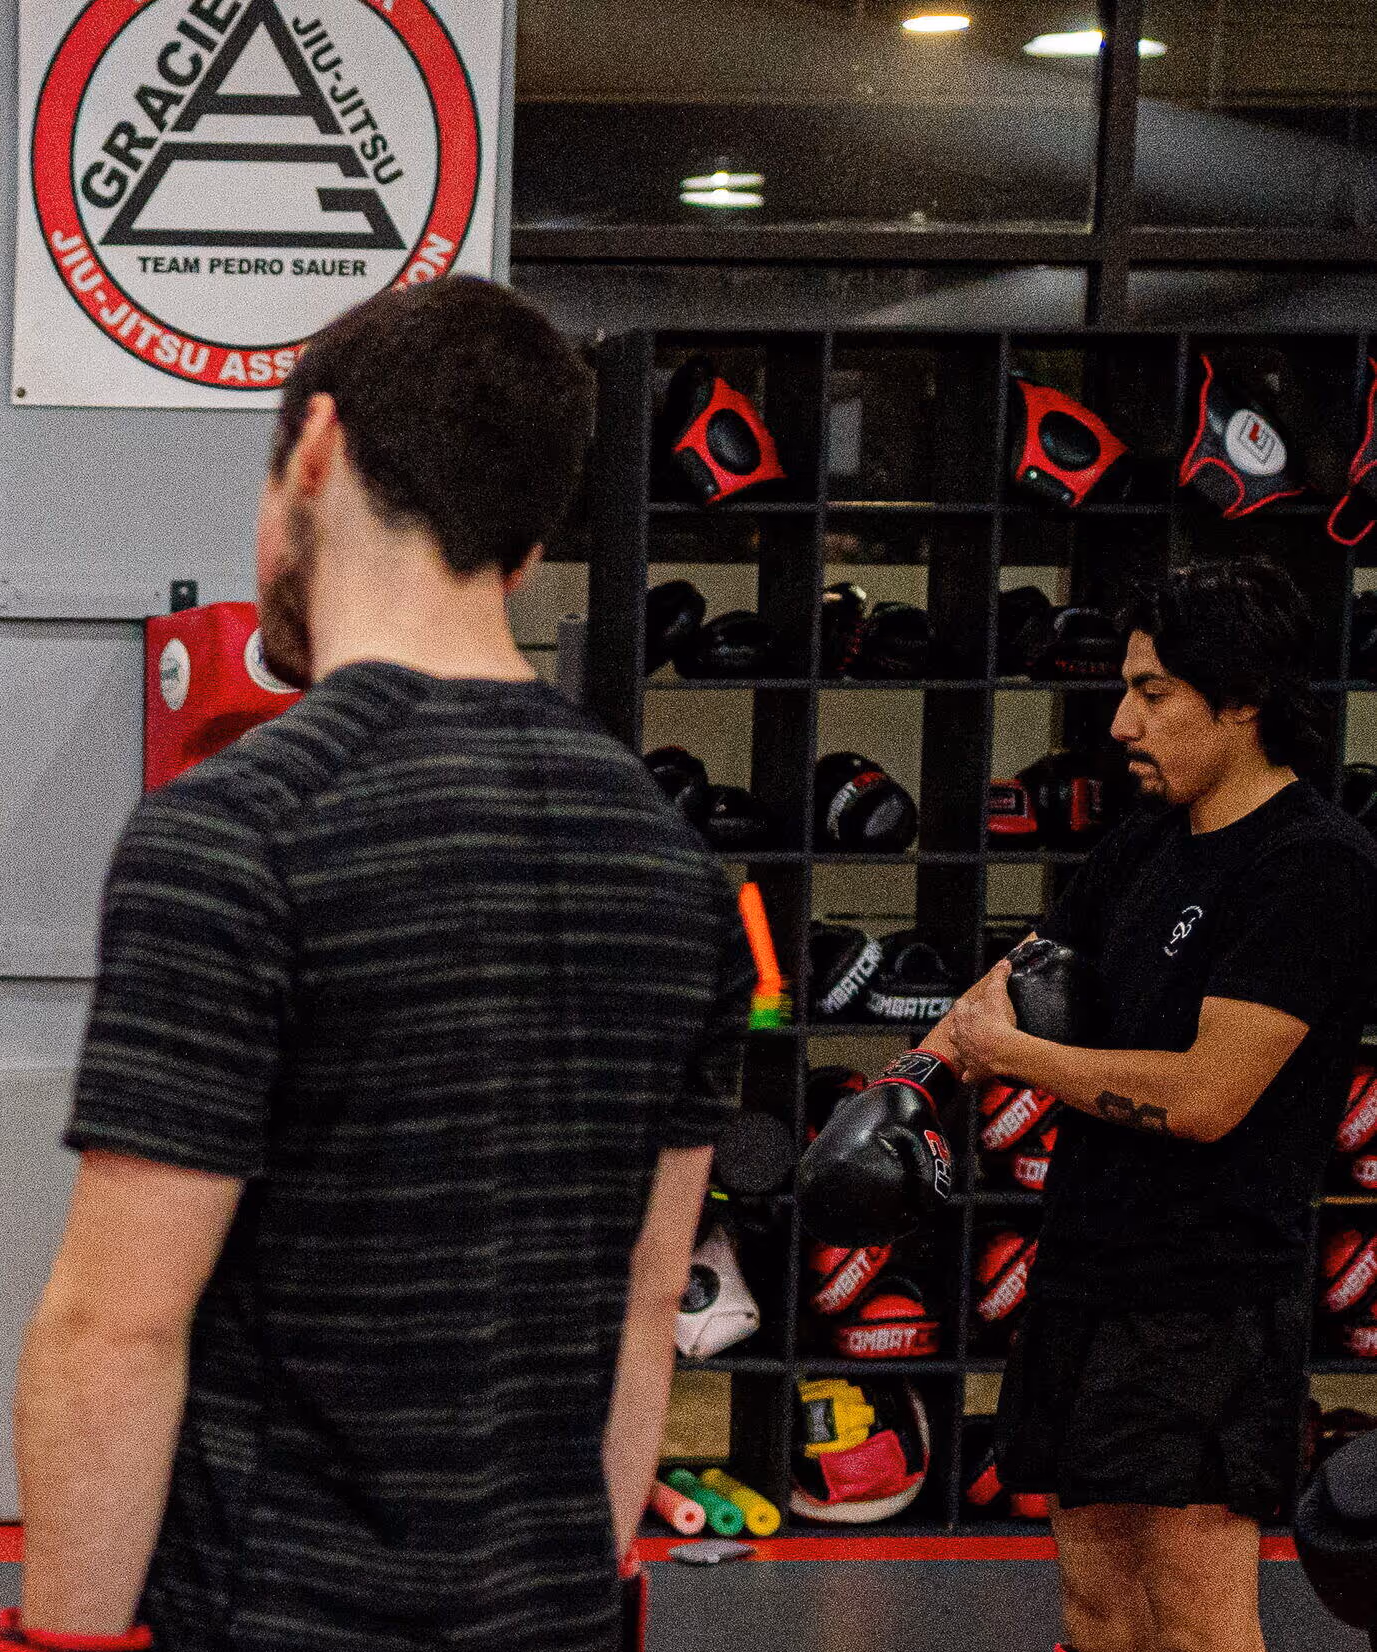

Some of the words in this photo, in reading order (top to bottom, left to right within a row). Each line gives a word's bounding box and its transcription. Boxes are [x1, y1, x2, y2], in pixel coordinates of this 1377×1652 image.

[81, 0, 243, 209] GRACIE
[291, 15, 404, 187] JIU-JITSU
[51, 228, 210, 375] JIU-JITSU
[137, 256, 200, 274] TEAM
[209, 257, 284, 276] PEDRO
[291, 258, 367, 277] SAUER
